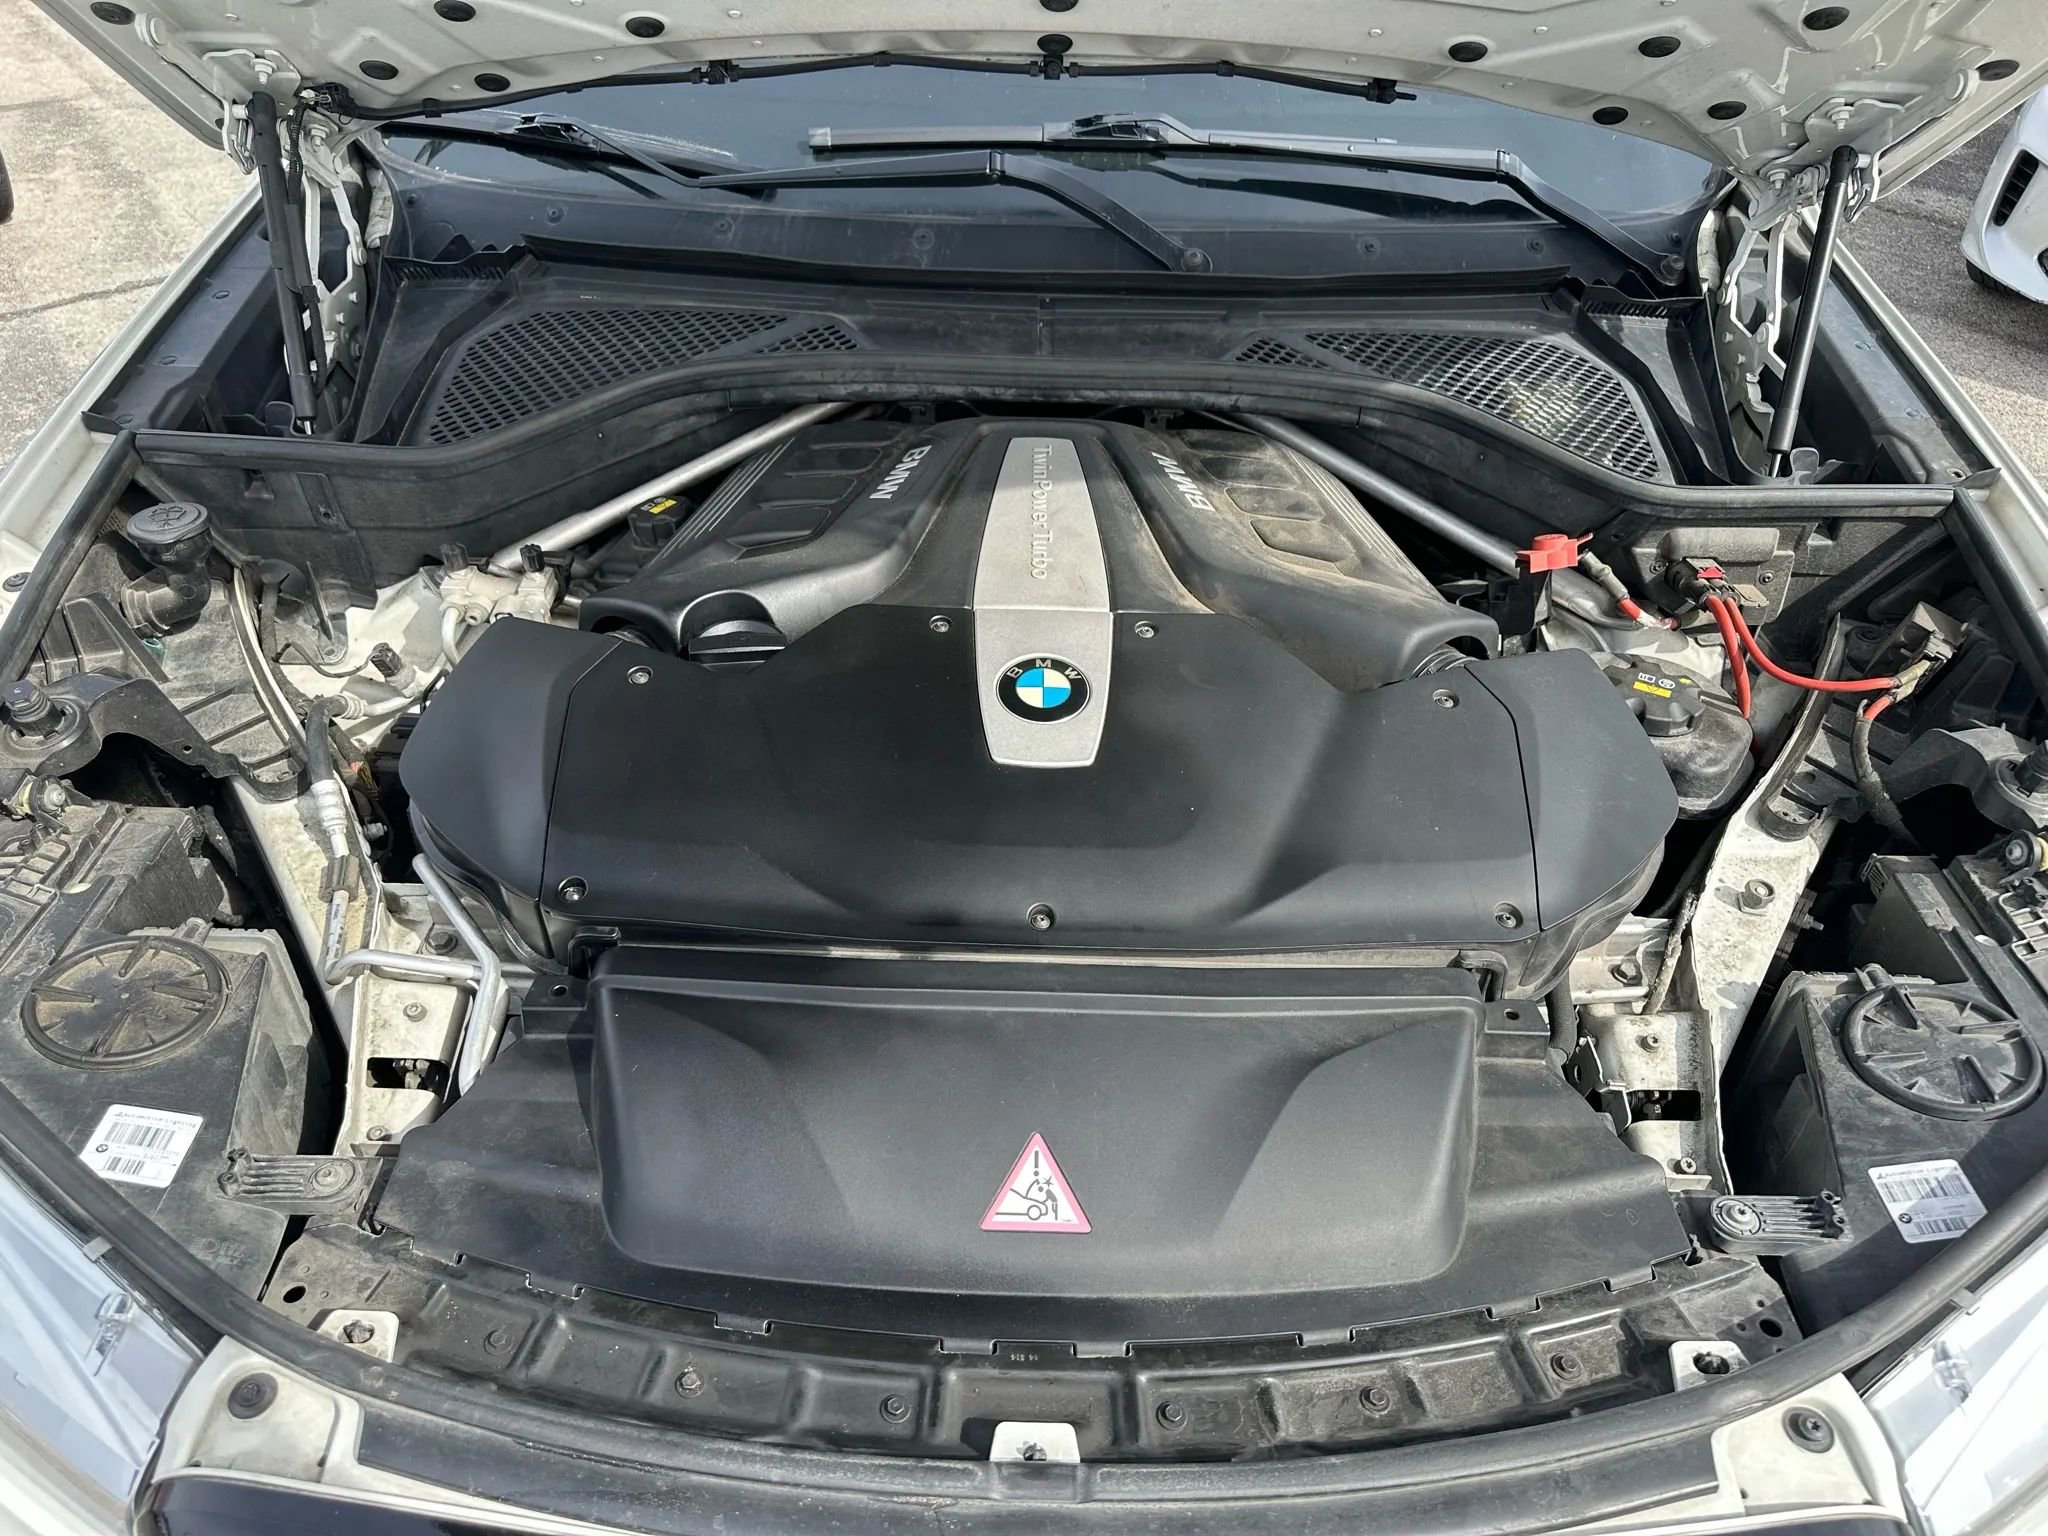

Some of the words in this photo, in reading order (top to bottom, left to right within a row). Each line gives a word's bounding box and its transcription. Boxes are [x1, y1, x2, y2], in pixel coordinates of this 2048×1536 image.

[869, 444, 932, 500] BMW
[1150, 450, 1216, 512] BMW
[1031, 529, 1053, 580] Turbo
[1006, 658, 1082, 679] BMW
